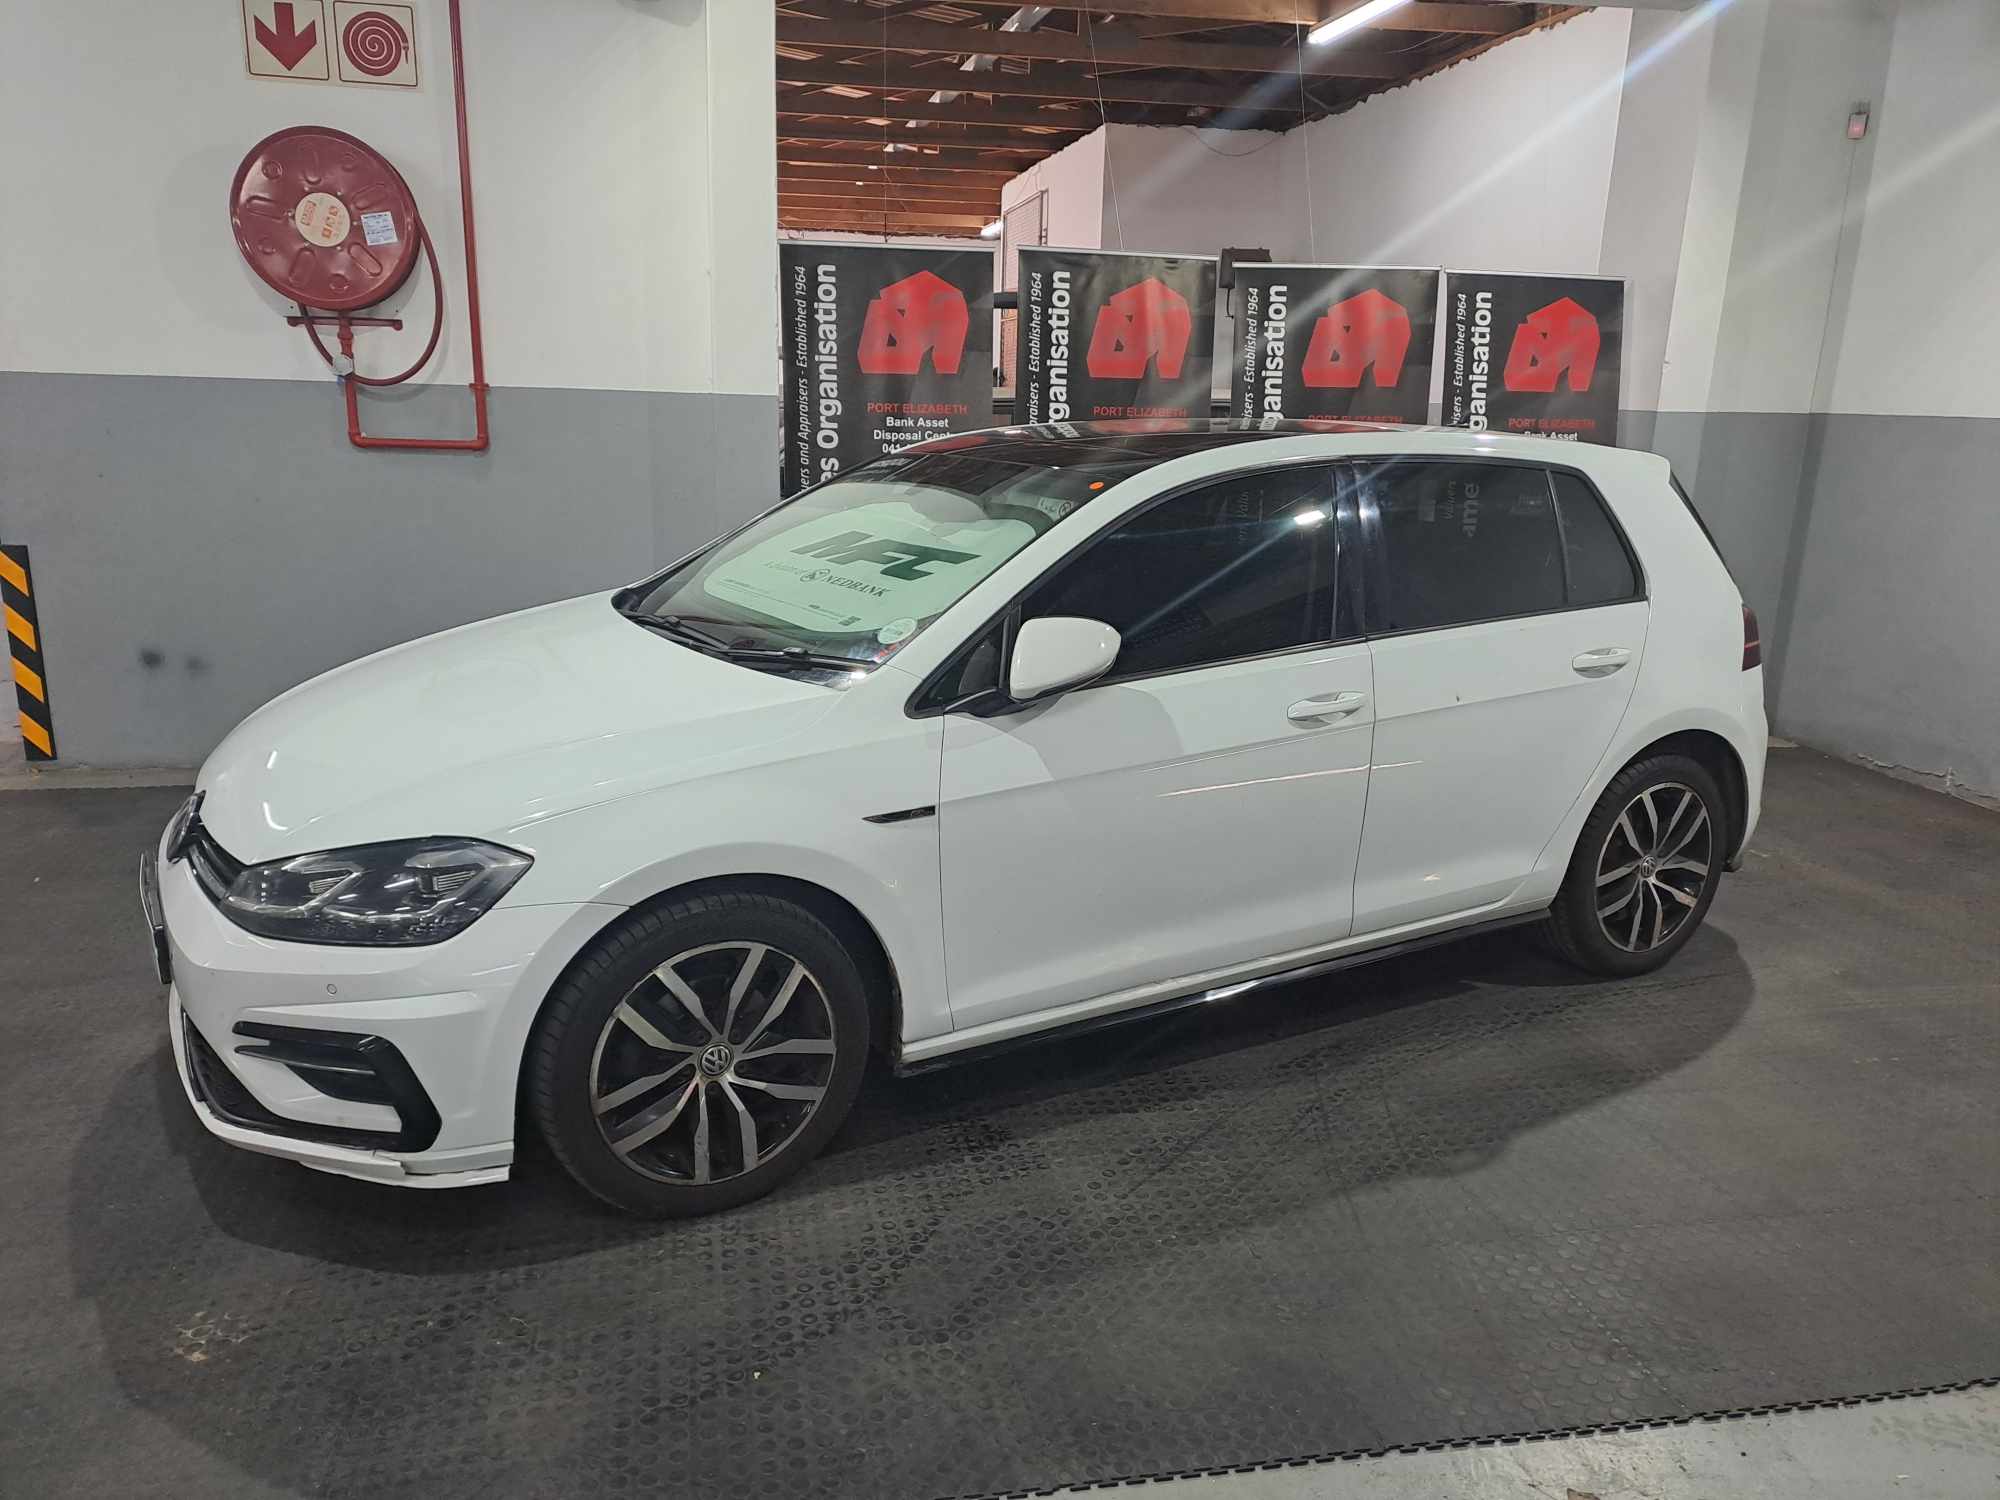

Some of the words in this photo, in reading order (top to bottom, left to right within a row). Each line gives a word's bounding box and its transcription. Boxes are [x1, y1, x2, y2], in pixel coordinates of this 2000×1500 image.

[794, 265, 807, 295] 1964
[1030, 272, 1042, 301] 1964
[1247, 287, 1259, 315] 1964
[1456, 293, 1467, 321] 1964
[794, 298, 808, 368] Established
[1028, 304, 1041, 373] Established
[814, 264, 842, 449] Organisation
[1243, 317, 1257, 383] Established
[1453, 323, 1466, 387] Established
[796, 377, 811, 440] Appraisers
[866, 402, 898, 414] PORT
[902, 403, 969, 415] ELIZABETH
[886, 416, 915, 427] Bank
[916, 416, 949, 428] Asset
[1093, 406, 1122, 417] PORT
[1126, 407, 1185, 417] ELIZABETH
[873, 429, 922, 443] Disposal
[796, 441, 809, 465] and
[823, 573, 893, 598] NEDBANK
